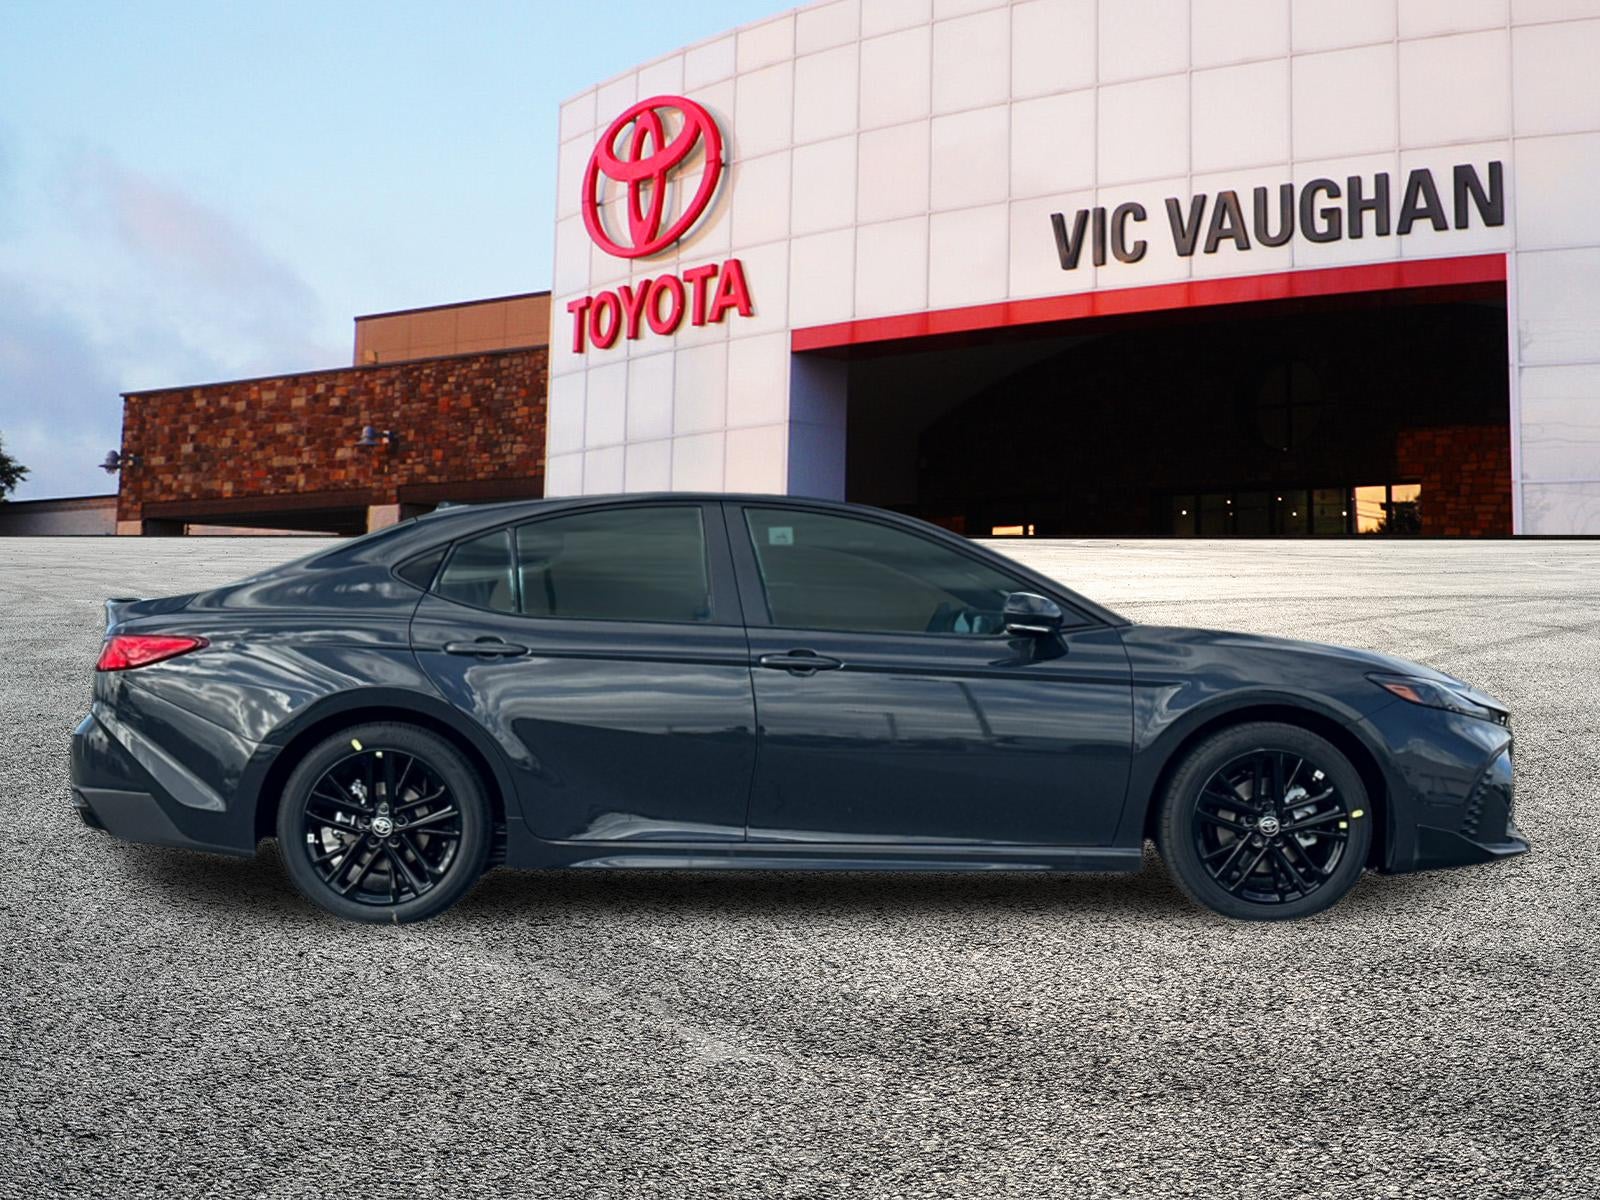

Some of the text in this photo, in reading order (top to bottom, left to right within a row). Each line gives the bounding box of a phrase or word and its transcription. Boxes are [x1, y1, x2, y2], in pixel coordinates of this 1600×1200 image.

[1050, 160, 1505, 270] VIC VAUGHAN
[567, 258, 754, 354] TOYOTA
